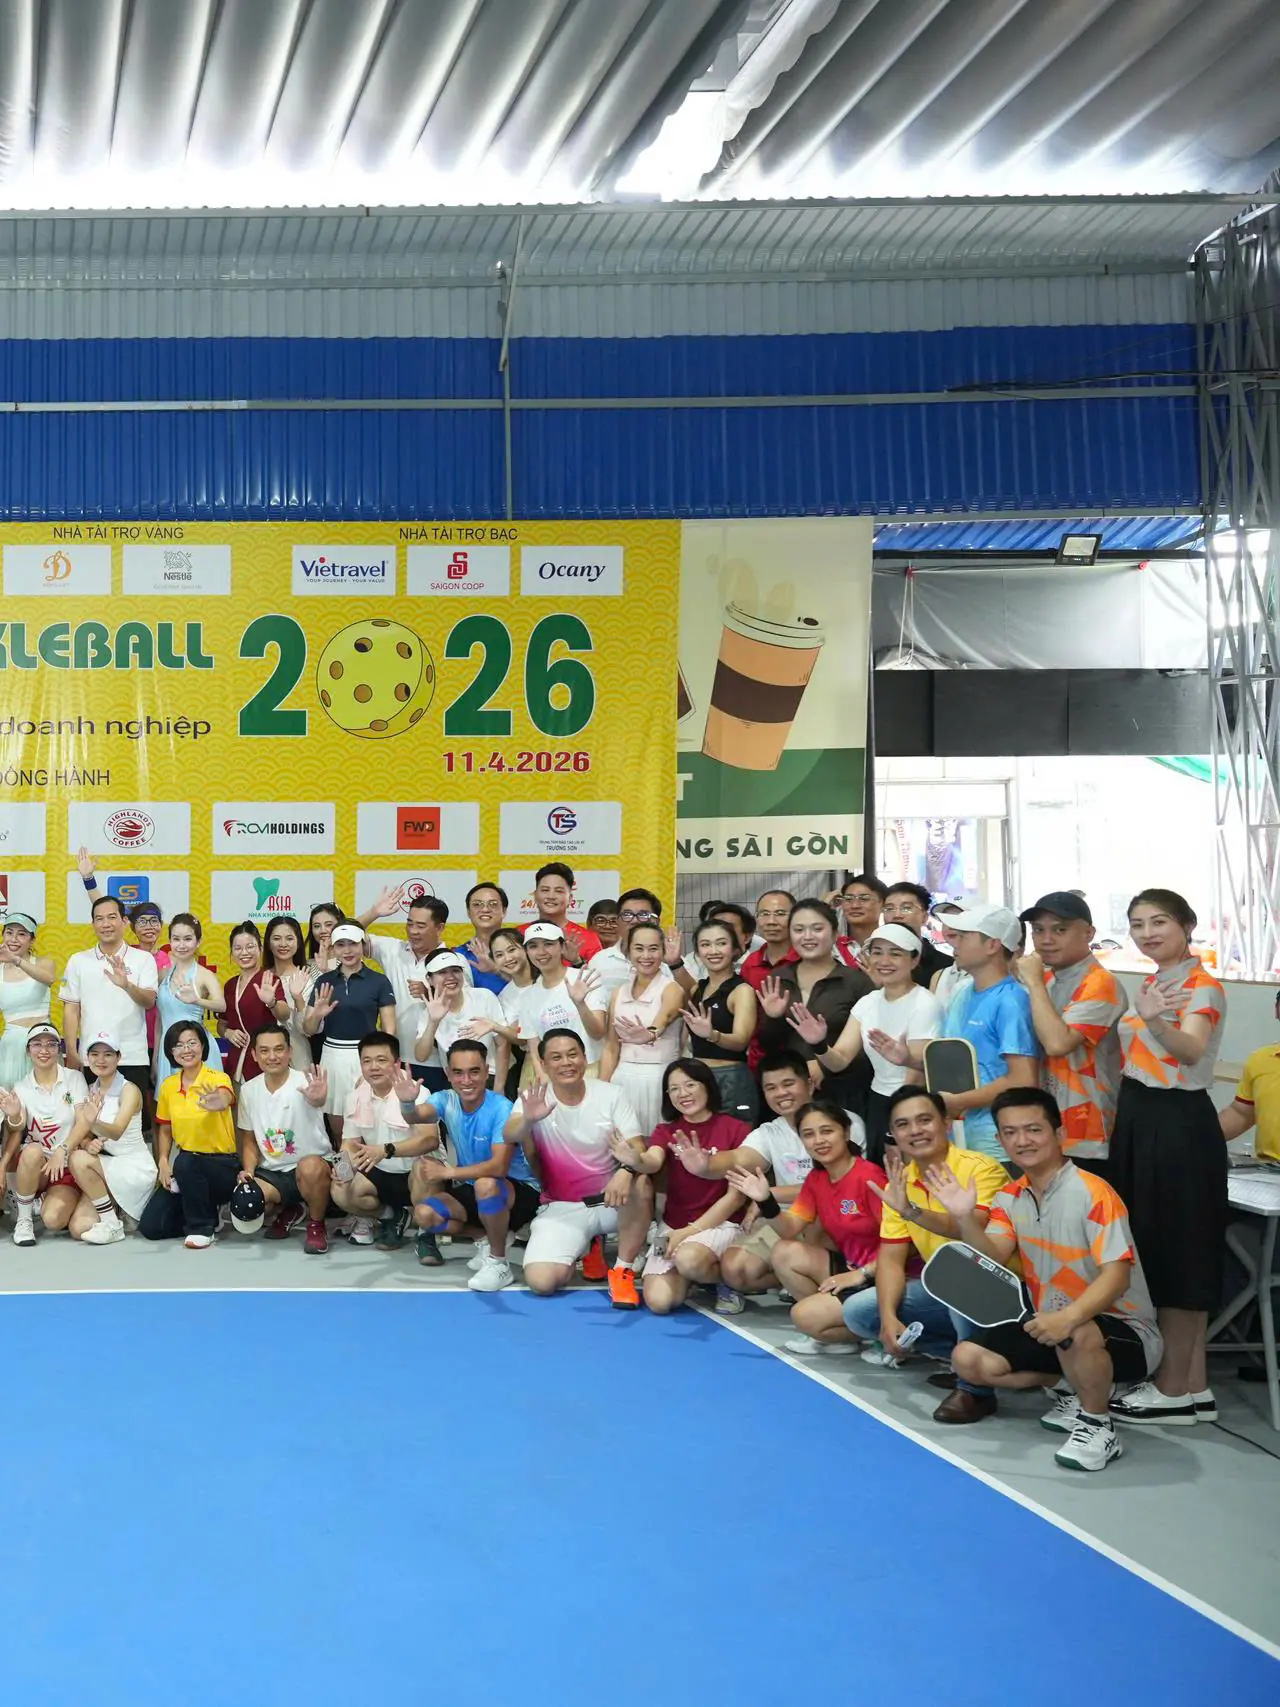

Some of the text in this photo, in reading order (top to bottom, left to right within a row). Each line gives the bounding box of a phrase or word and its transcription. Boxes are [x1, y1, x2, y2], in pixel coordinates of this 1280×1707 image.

[53, 525, 184, 541] NHÀ TÀI TRỢ VÀNG
[399, 527, 518, 542] NHÀ TÀI TRỢ BẠC
[300, 557, 386, 577] Vietravel
[538, 562, 606, 582] Ocany
[105, 714, 212, 742] nghiệp
[441, 750, 591, 774] 11.4.2026
[55, 766, 110, 787] HÀNH
[107, 811, 152, 828] HIGHLANDS
[403, 821, 434, 832] FWD
[112, 836, 147, 847] COFFEE
[727, 833, 772, 858] SÀI
[786, 831, 848, 856] GÒN
[268, 895, 291, 911] ASIA
